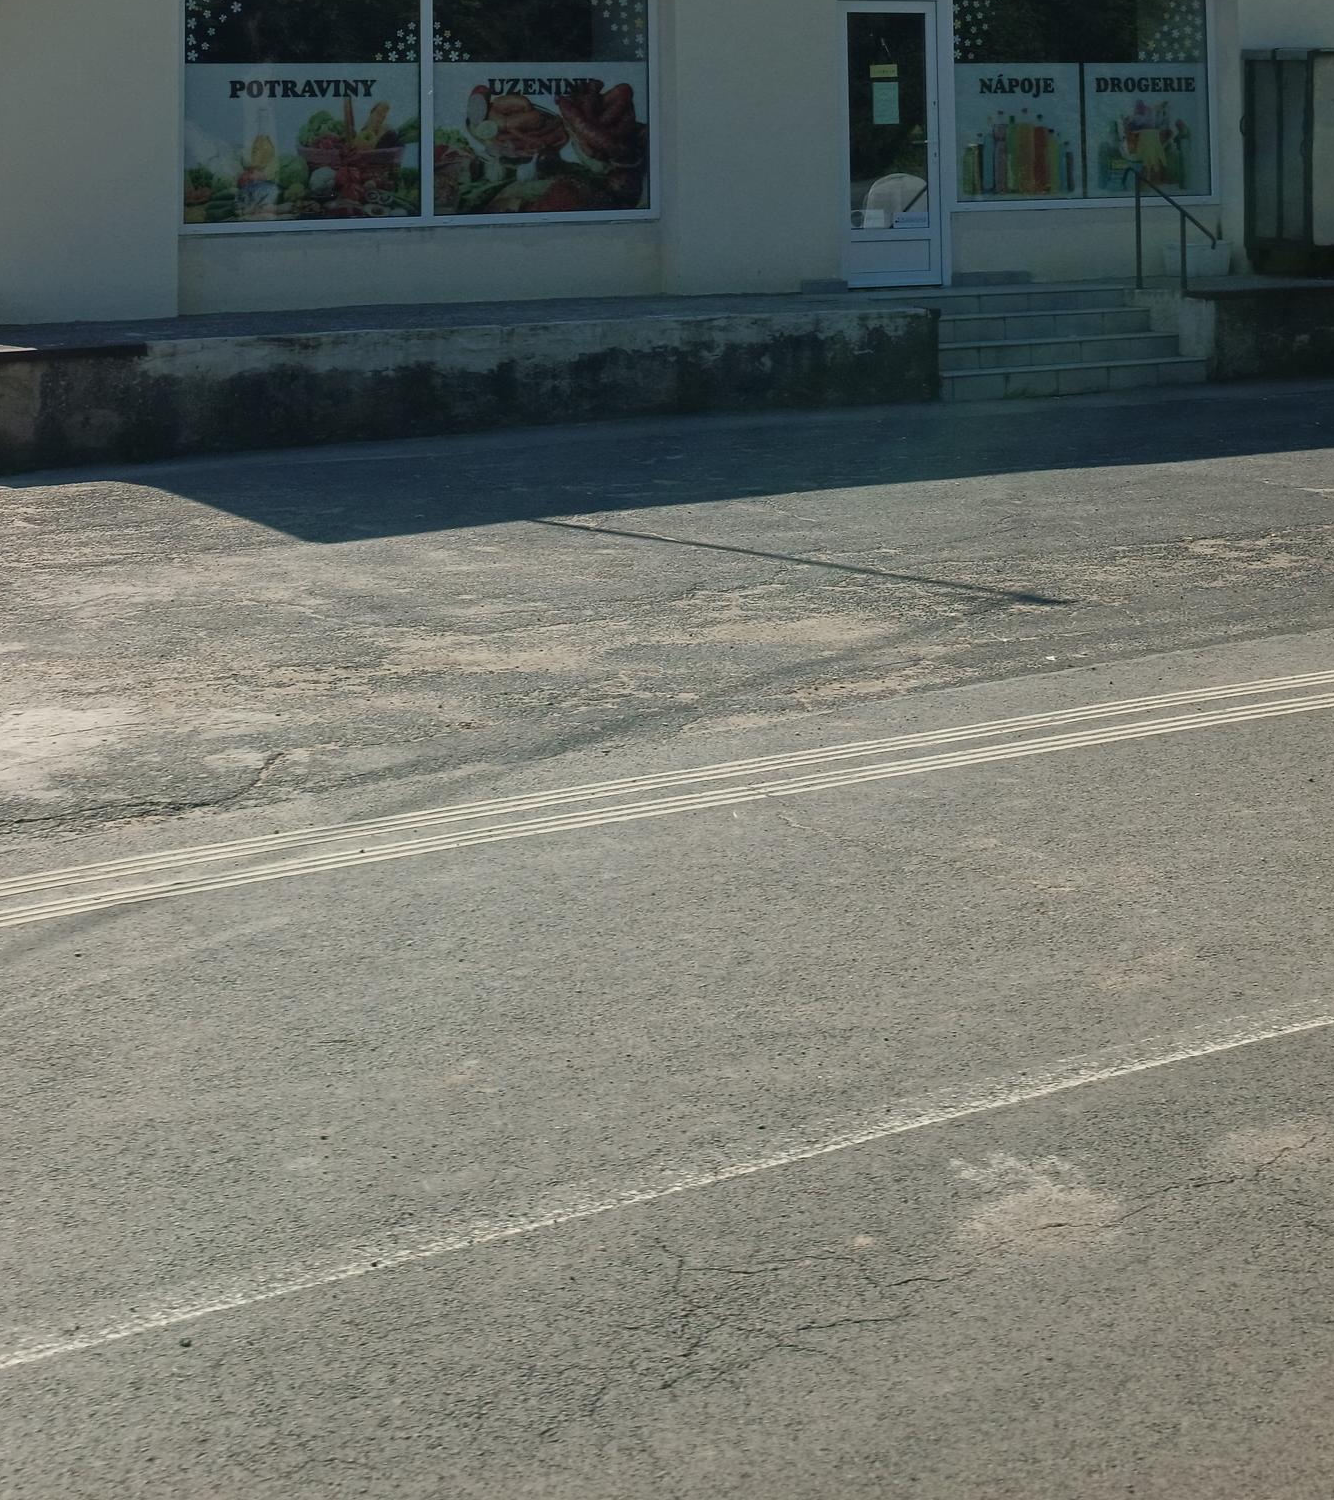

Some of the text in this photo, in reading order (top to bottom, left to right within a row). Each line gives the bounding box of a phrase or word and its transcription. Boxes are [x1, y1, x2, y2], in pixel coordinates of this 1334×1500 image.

[229, 79, 376, 98] POTRAVINY
[979, 74, 1054, 97] NÁPOJE
[1095, 77, 1195, 92] DROGERIE
